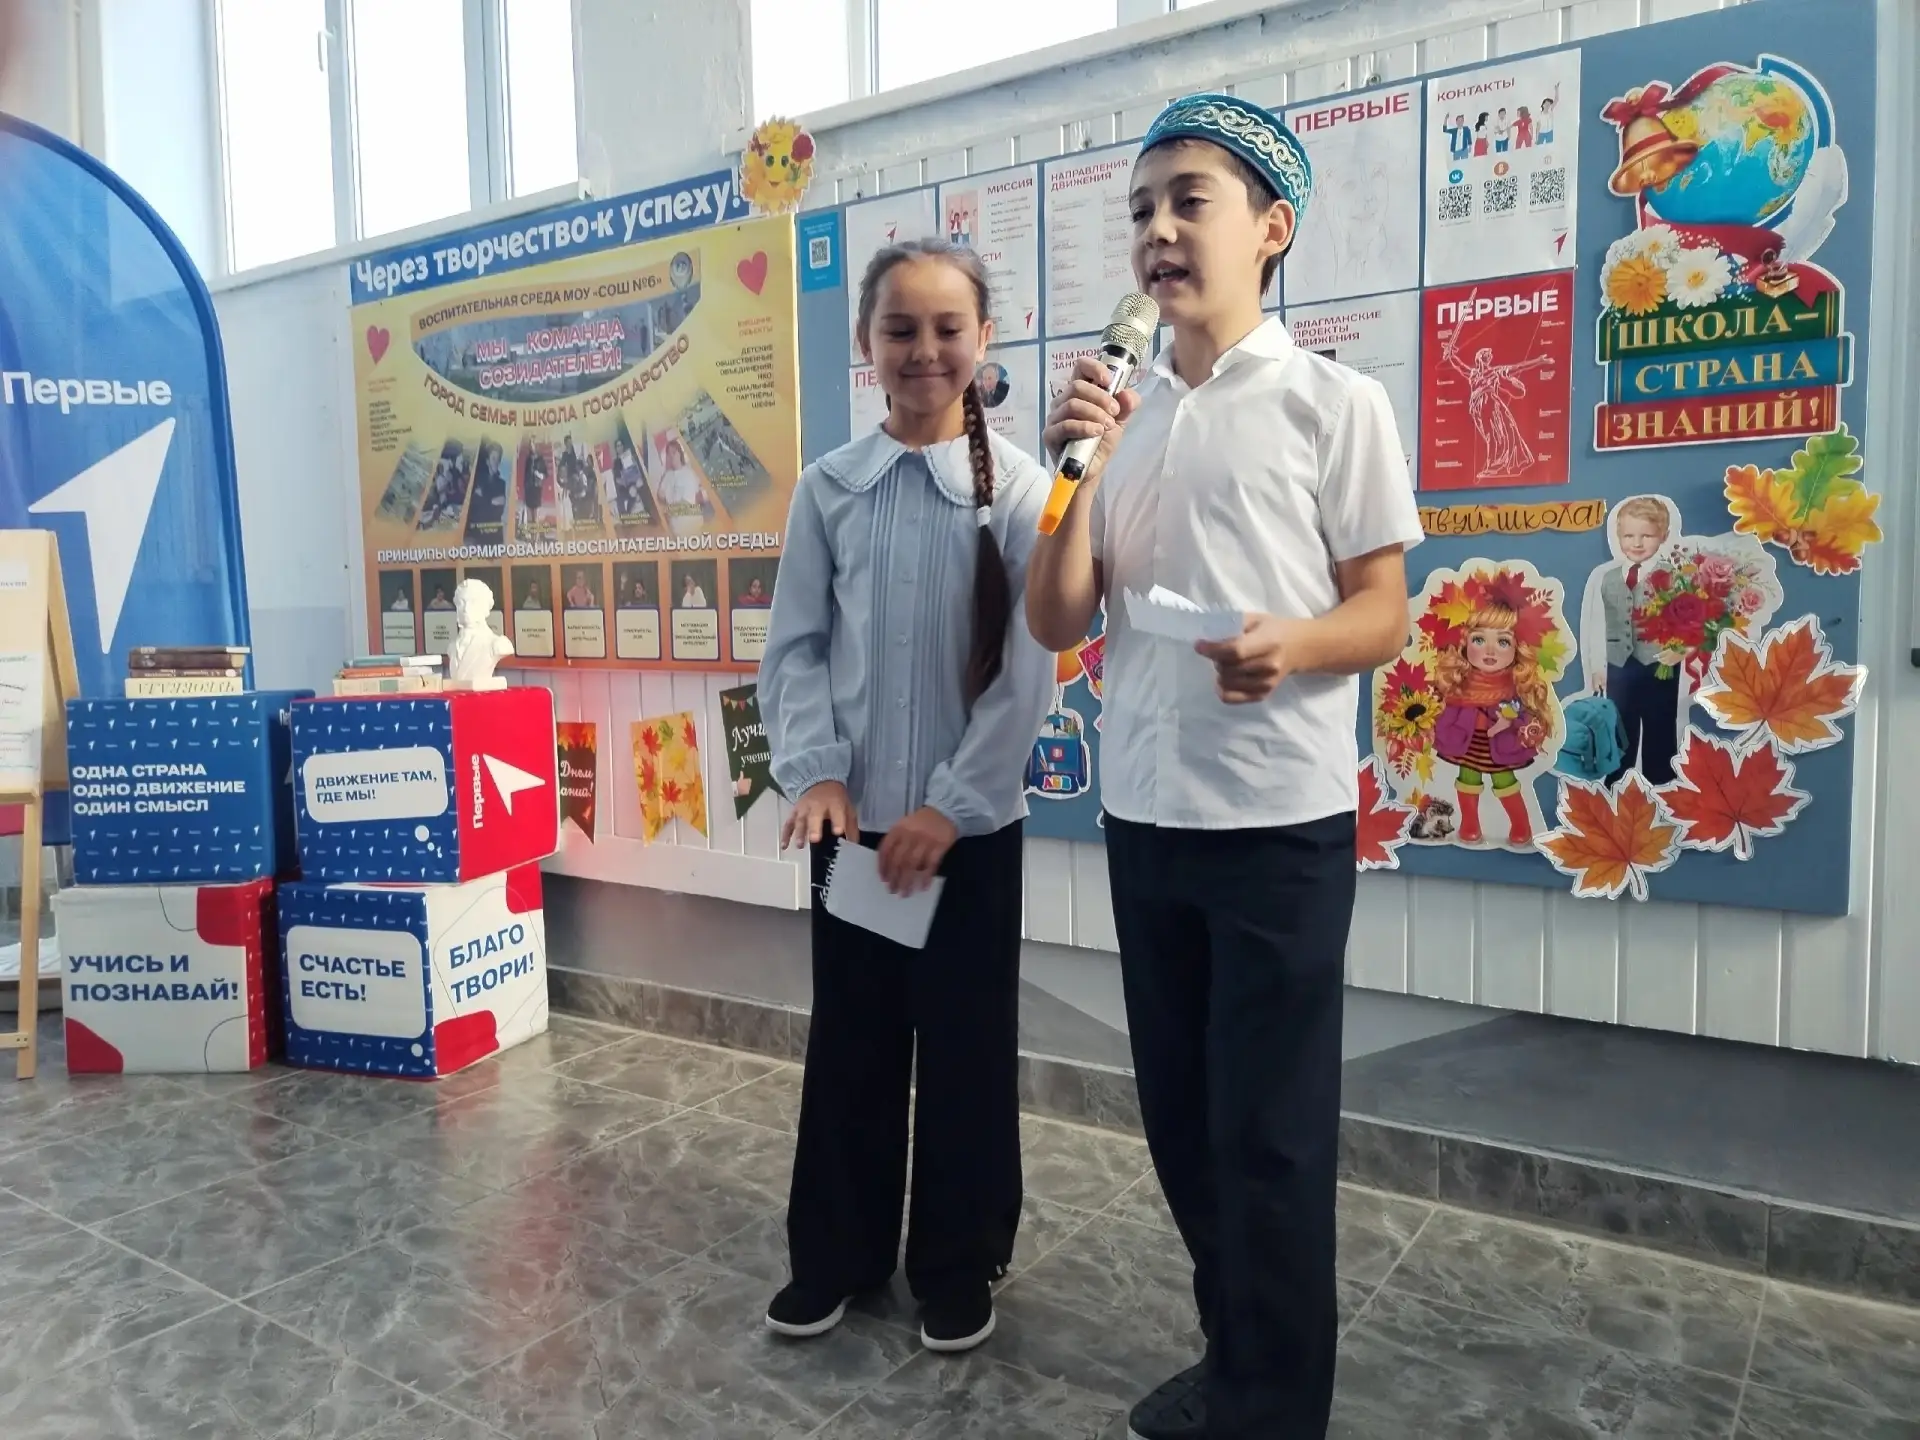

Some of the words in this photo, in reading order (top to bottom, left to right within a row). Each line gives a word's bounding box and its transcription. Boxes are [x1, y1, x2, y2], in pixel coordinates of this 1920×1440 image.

[1437, 77, 1515, 103] КОНТАКТЫ
[1295, 92, 1410, 135] ПЕРВЫЕ
[1051, 159, 1128, 182] НАПРАВЛЕНИЯ
[1051, 172, 1112, 192] ДВИЖЕНИЯ
[987, 178, 1033, 195] МИССИЯ
[355, 258, 429, 294] Через
[621, 173, 741, 243] успеху!
[418, 294, 518, 330] ВОСПИТАТЕЛЬНАЯ
[519, 290, 561, 307] СРЕДА
[563, 287, 591, 302] МОУ
[592, 280, 630, 299] «СОШ
[1437, 289, 1558, 325] ПЕРВЫЕ
[1293, 310, 1382, 330] ФЛАГМАНСКИЕ
[1293, 324, 1349, 339] ПРОЕКТЫ
[475, 341, 508, 363] МЫ
[525, 320, 625, 354] КОМАНДА
[1293, 332, 1360, 348] ДВИЖЕНИЯ
[478, 347, 623, 389] СОЗИДАТЕЛЕЙ!
[1051, 351, 1074, 361] ЧЕМ
[424, 374, 465, 418] ГОРОД
[469, 403, 517, 427] СЕМЬЯ
[522, 404, 578, 427] ШКОЛА
[582, 333, 690, 418] ГОСУДАРСТВО
[1634, 351, 1820, 393] СТРАНА
[2, 371, 173, 415] Первые
[1612, 390, 1820, 442] ЗНАНИЙ!
[1497, 500, 1602, 532] школа!
[377, 547, 447, 563] ПРИНЦИПЫ
[448, 541, 565, 560] ФОРМИРОВАНИЯ
[566, 532, 712, 556] ВОСПИТАТЕЛЬНОЙ
[716, 532, 781, 550] СРЕДЫ
[72, 764, 128, 781] ОДНА
[132, 762, 207, 778] СТРАНА
[315, 771, 399, 789] ДВИЖЕНИЕ
[401, 769, 437, 786] ТАМ,
[73, 782, 130, 798] ОДНО
[134, 779, 246, 797] ДВИЖЕНИЕ
[316, 791, 344, 804] ГДЕ
[346, 787, 377, 803] МЫ!
[471, 753, 485, 829] Первые
[74, 799, 134, 816] ОДИН
[135, 798, 209, 814] СМЫСЛ
[449, 924, 525, 970] БЛАГО
[68, 954, 163, 974] УЧИСЬ
[171, 954, 190, 973] И
[299, 953, 406, 978] СЧАСТЬЕ
[69, 977, 239, 1002] ПОЗНАВАЙ!
[450, 951, 535, 1003] ТВОРИ!
[300, 982, 367, 1002] ЕСТЬ!
